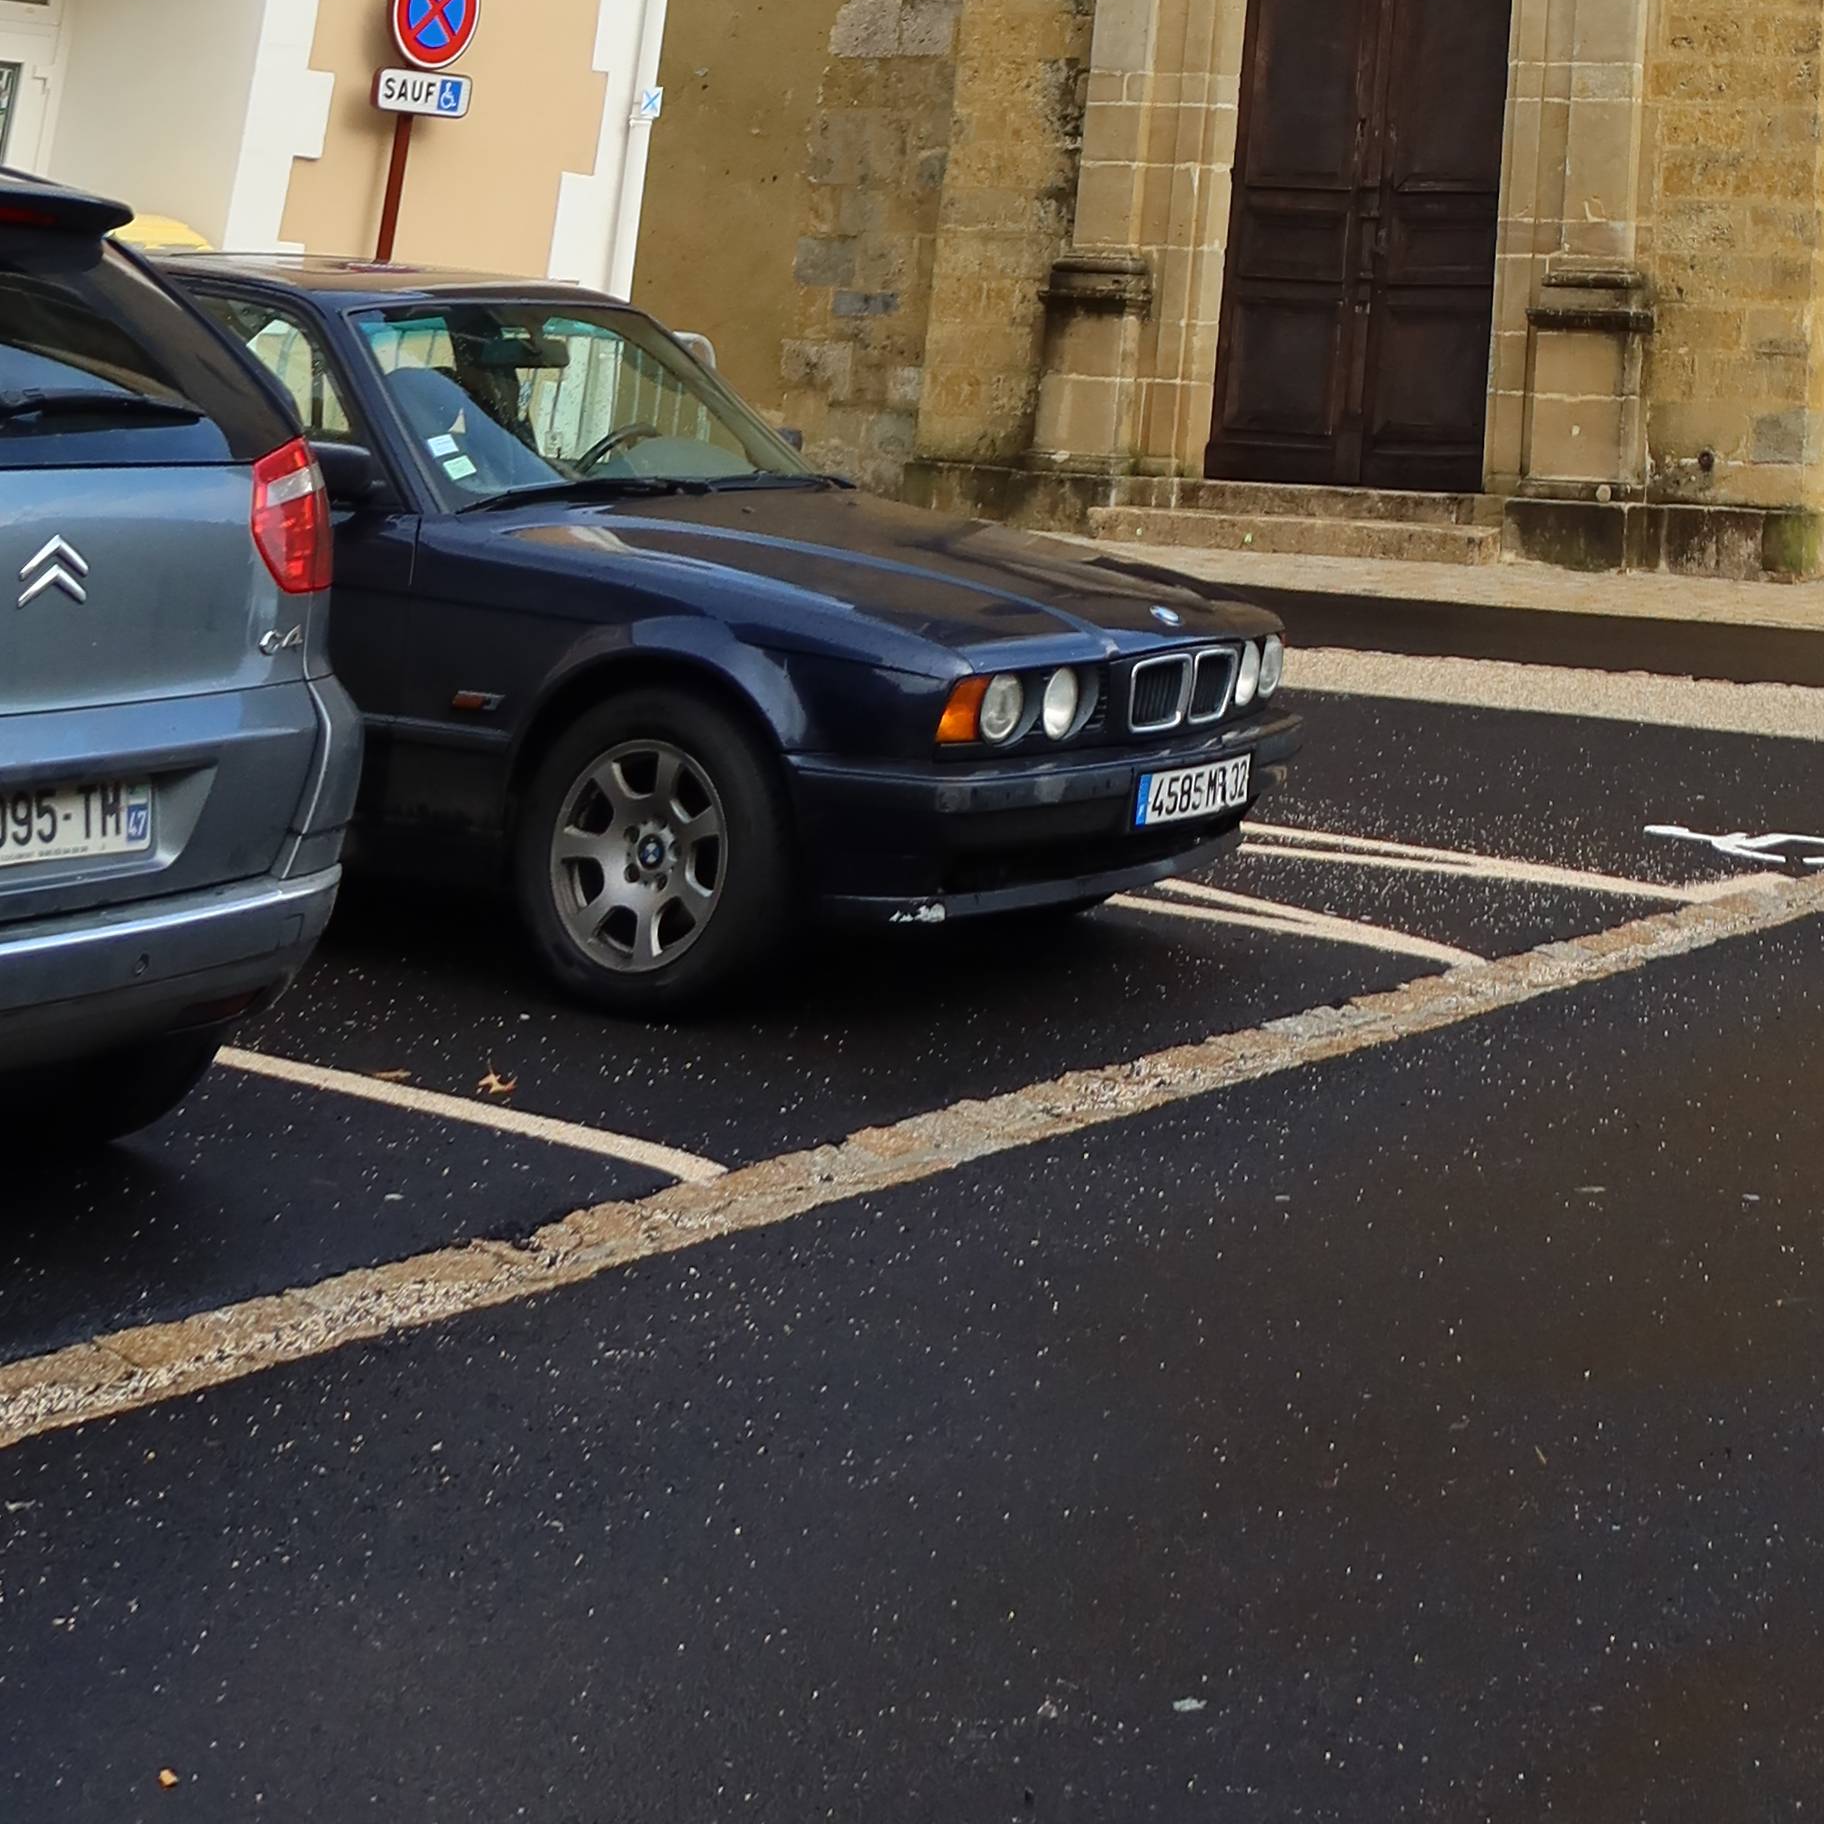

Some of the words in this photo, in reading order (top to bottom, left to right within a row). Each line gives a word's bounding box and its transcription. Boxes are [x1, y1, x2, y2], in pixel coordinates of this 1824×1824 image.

[383, 77, 436, 103] SAUF
[258, 624, 303, 656] C4
[128, 809, 148, 837] 47
